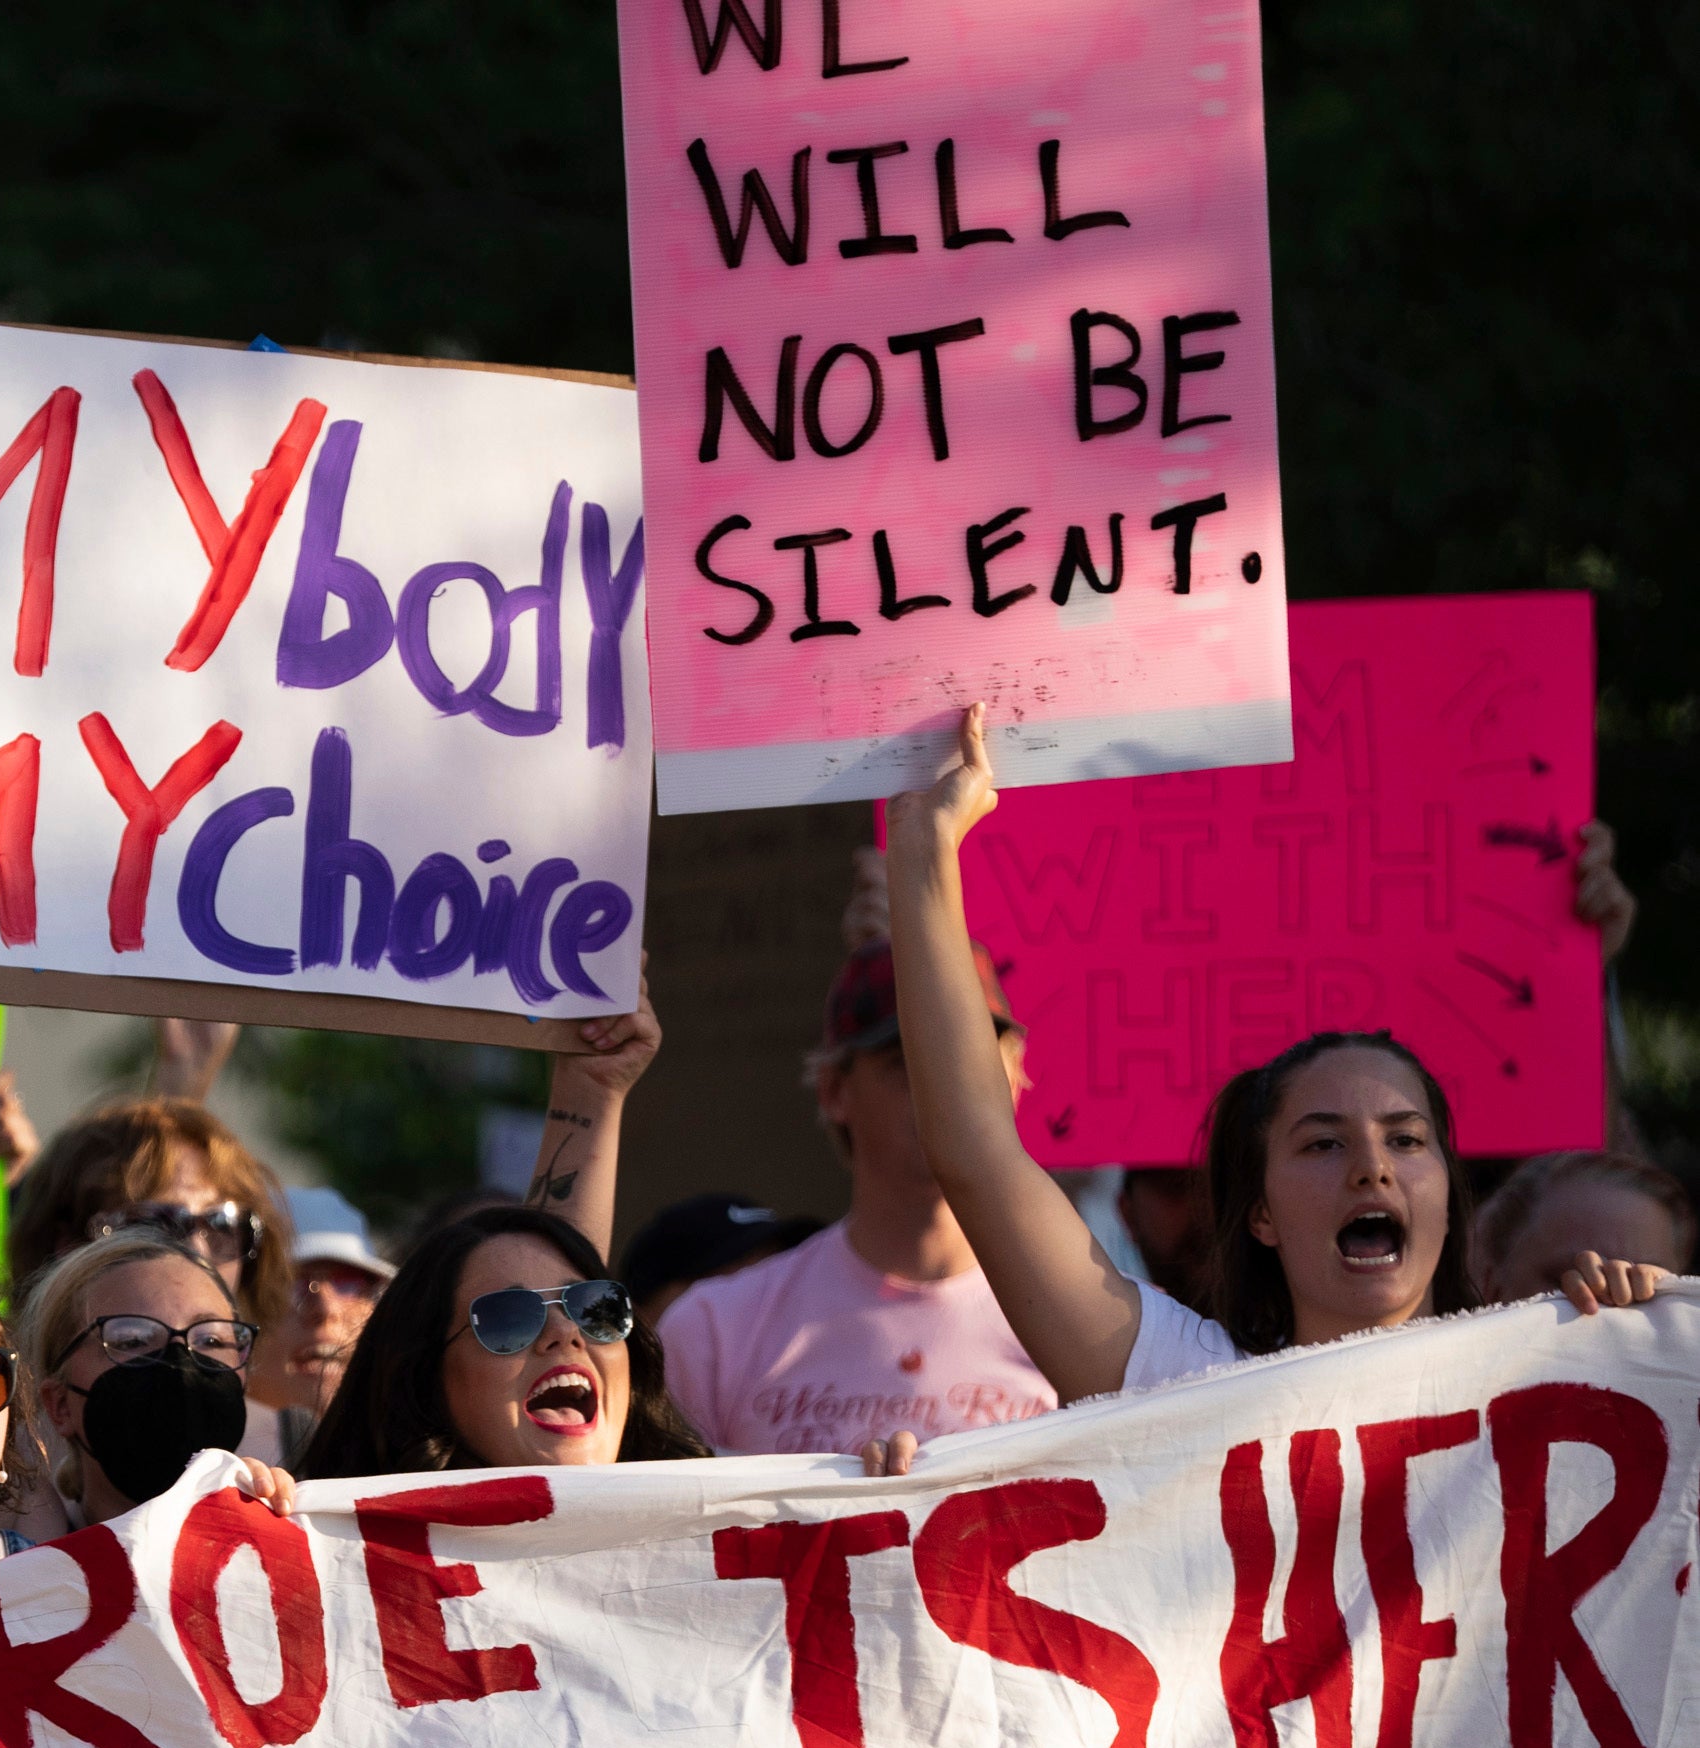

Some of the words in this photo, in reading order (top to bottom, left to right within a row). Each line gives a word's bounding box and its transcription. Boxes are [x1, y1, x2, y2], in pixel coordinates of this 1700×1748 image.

[687, 136, 1132, 269] WILL
[698, 316, 986, 463] NOT
[1070, 307, 1240, 442] BE
[694, 492, 1263, 646] SILENT.
[177, 724, 635, 1005] Choice
[980, 800, 1457, 947] WITH
